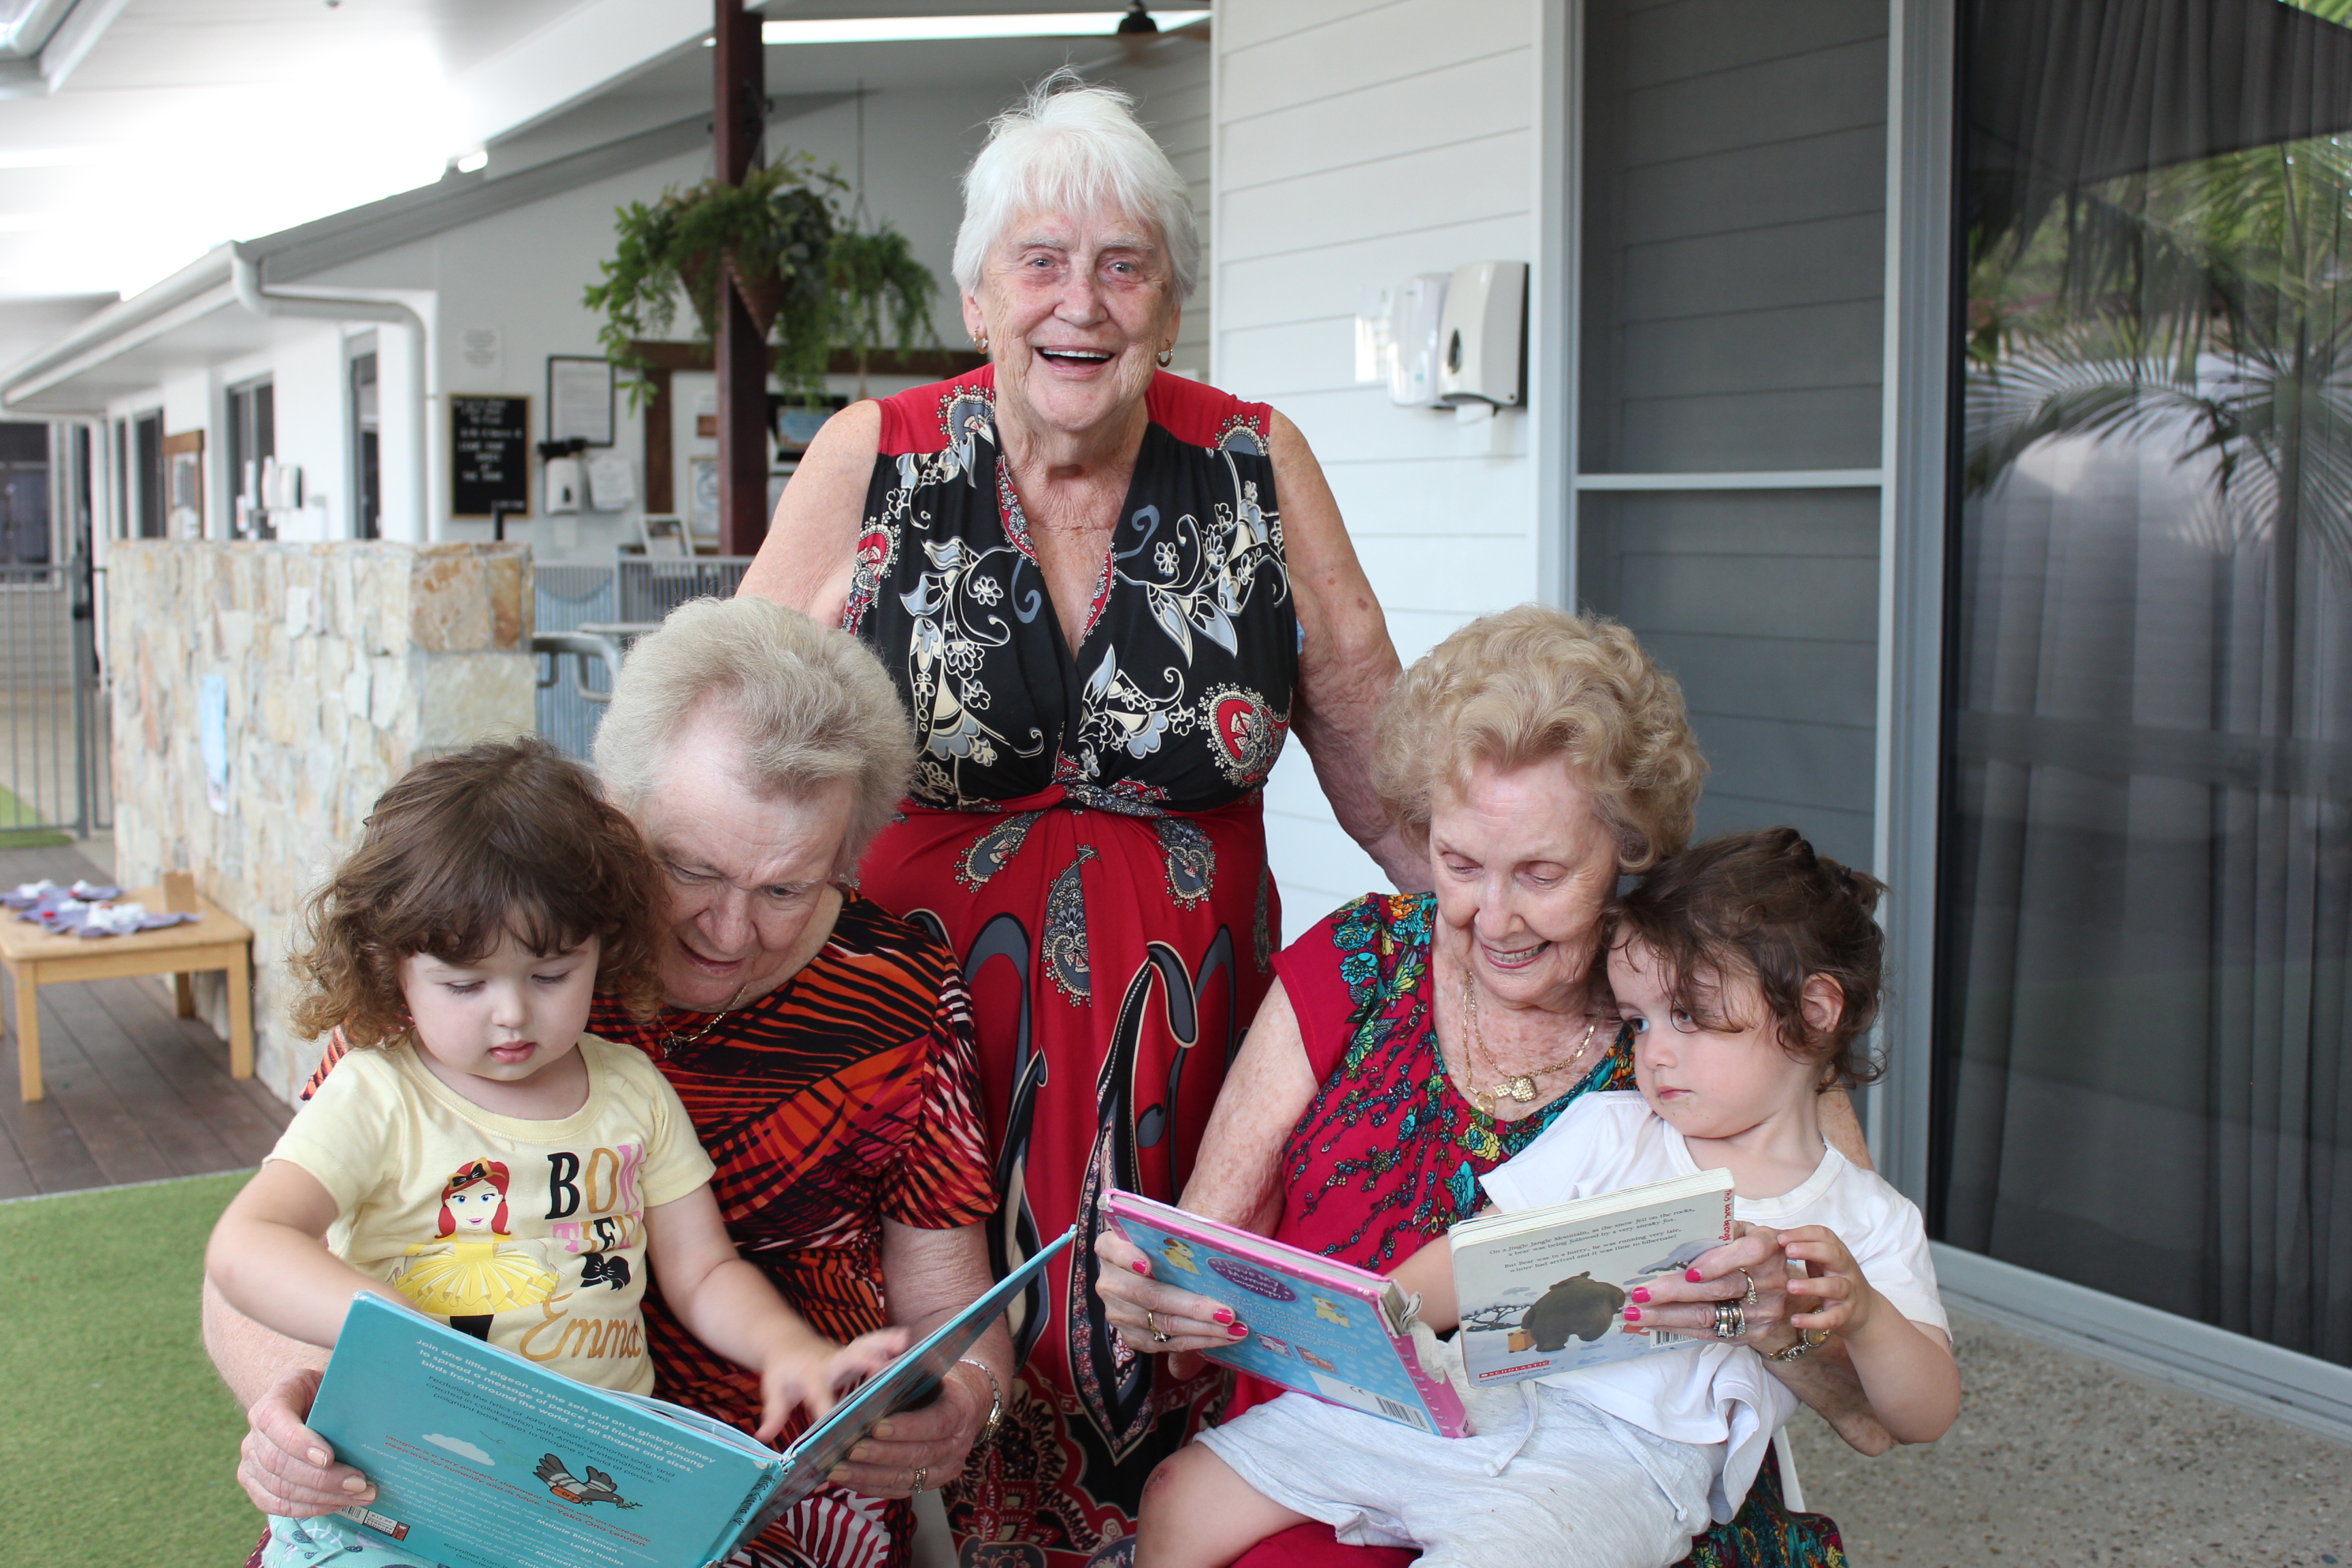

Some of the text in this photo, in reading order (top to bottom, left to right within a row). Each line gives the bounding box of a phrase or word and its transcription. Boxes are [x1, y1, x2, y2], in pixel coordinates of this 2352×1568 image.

[1724, 1190, 1732, 1202] This
[1507, 1244, 1529, 1252] Jingle
[1529, 1239, 1552, 1247] Jangle
[1554, 1230, 1590, 1241] Mountain,
[1569, 1234, 1599, 1244] followed
[1636, 1220, 1661, 1229] sneaky
[1618, 1235, 1647, 1244] running
[1550, 1256, 1575, 1264] arrived
[1642, 1234, 1677, 1245] hibernate!
[1225, 1261, 1256, 1277] Love
[1228, 1269, 1277, 1292] Mummy
[520, 1292, 641, 1361] Emma
[1480, 1367, 1550, 1383] www.scholastic.com.au
[1489, 1361, 1548, 1375] SCHOLASTIC
[416, 1339, 438, 1352] Join
[441, 1350, 463, 1361] one
[466, 1359, 487, 1371] little
[489, 1371, 528, 1388] pigeon
[546, 1394, 566, 1403] she
[568, 1402, 588, 1413] sets
[591, 1411, 609, 1421] out
[638, 1431, 674, 1446] global
[674, 1443, 716, 1463] journey
[433, 1356, 471, 1374] spread
[484, 1377, 533, 1399] message
[549, 1403, 585, 1420] peace
[588, 1420, 610, 1430] and
[611, 1428, 663, 1451] friendship
[666, 1450, 704, 1468] among
[421, 1360, 447, 1373] birds
[450, 1371, 474, 1385] from
[477, 1384, 517, 1402] around
[519, 1399, 536, 1409] the
[539, 1408, 570, 1424] world,
[602, 1434, 640, 1451] shapes
[642, 1450, 664, 1460] and
[666, 1459, 693, 1473] sizes.
[426, 1383, 463, 1399] created
[474, 1403, 534, 1428] collaboration
[536, 1428, 554, 1437] with
[556, 1436, 595, 1452] Amnesty
[596, 1451, 652, 1475] International,
[429, 1376, 470, 1396] Featuring
[473, 1394, 487, 1402] the
[489, 1401, 510, 1411] lyrics
[525, 1416, 546, 1426] John
[548, 1424, 587, 1443] Lennon's
[589, 1441, 629, 1459] immortal
[630, 1458, 652, 1469] song,
[656, 1469, 675, 1477] and
[433, 1394, 474, 1411] poignant
[476, 1410, 499, 1422] book
[502, 1421, 525, 1433] dares
[540, 1435, 576, 1452] imagine
[587, 1454, 611, 1466] world
[623, 1470, 655, 1484] peace.
[385, 1435, 421, 1451] Imagine
[440, 1457, 458, 1466] very
[460, 1466, 498, 1482] powerful
[500, 1481, 542, 1499] statement,
[546, 1499, 574, 1512] written
[576, 1512, 593, 1520] with
[608, 1524, 651, 1542] incredible
[385, 1442, 408, 1453] deep
[410, 1452, 429, 1460] love
[444, 1465, 484, 1483] humanity
[486, 1482, 504, 1490] and
[516, 1494, 541, 1507] future.
[557, 1509, 582, 1522] Yoko
[585, 1520, 606, 1531] Ono
[609, 1530, 645, 1546] Lennon
[444, 1543, 500, 1567] Royalties from
